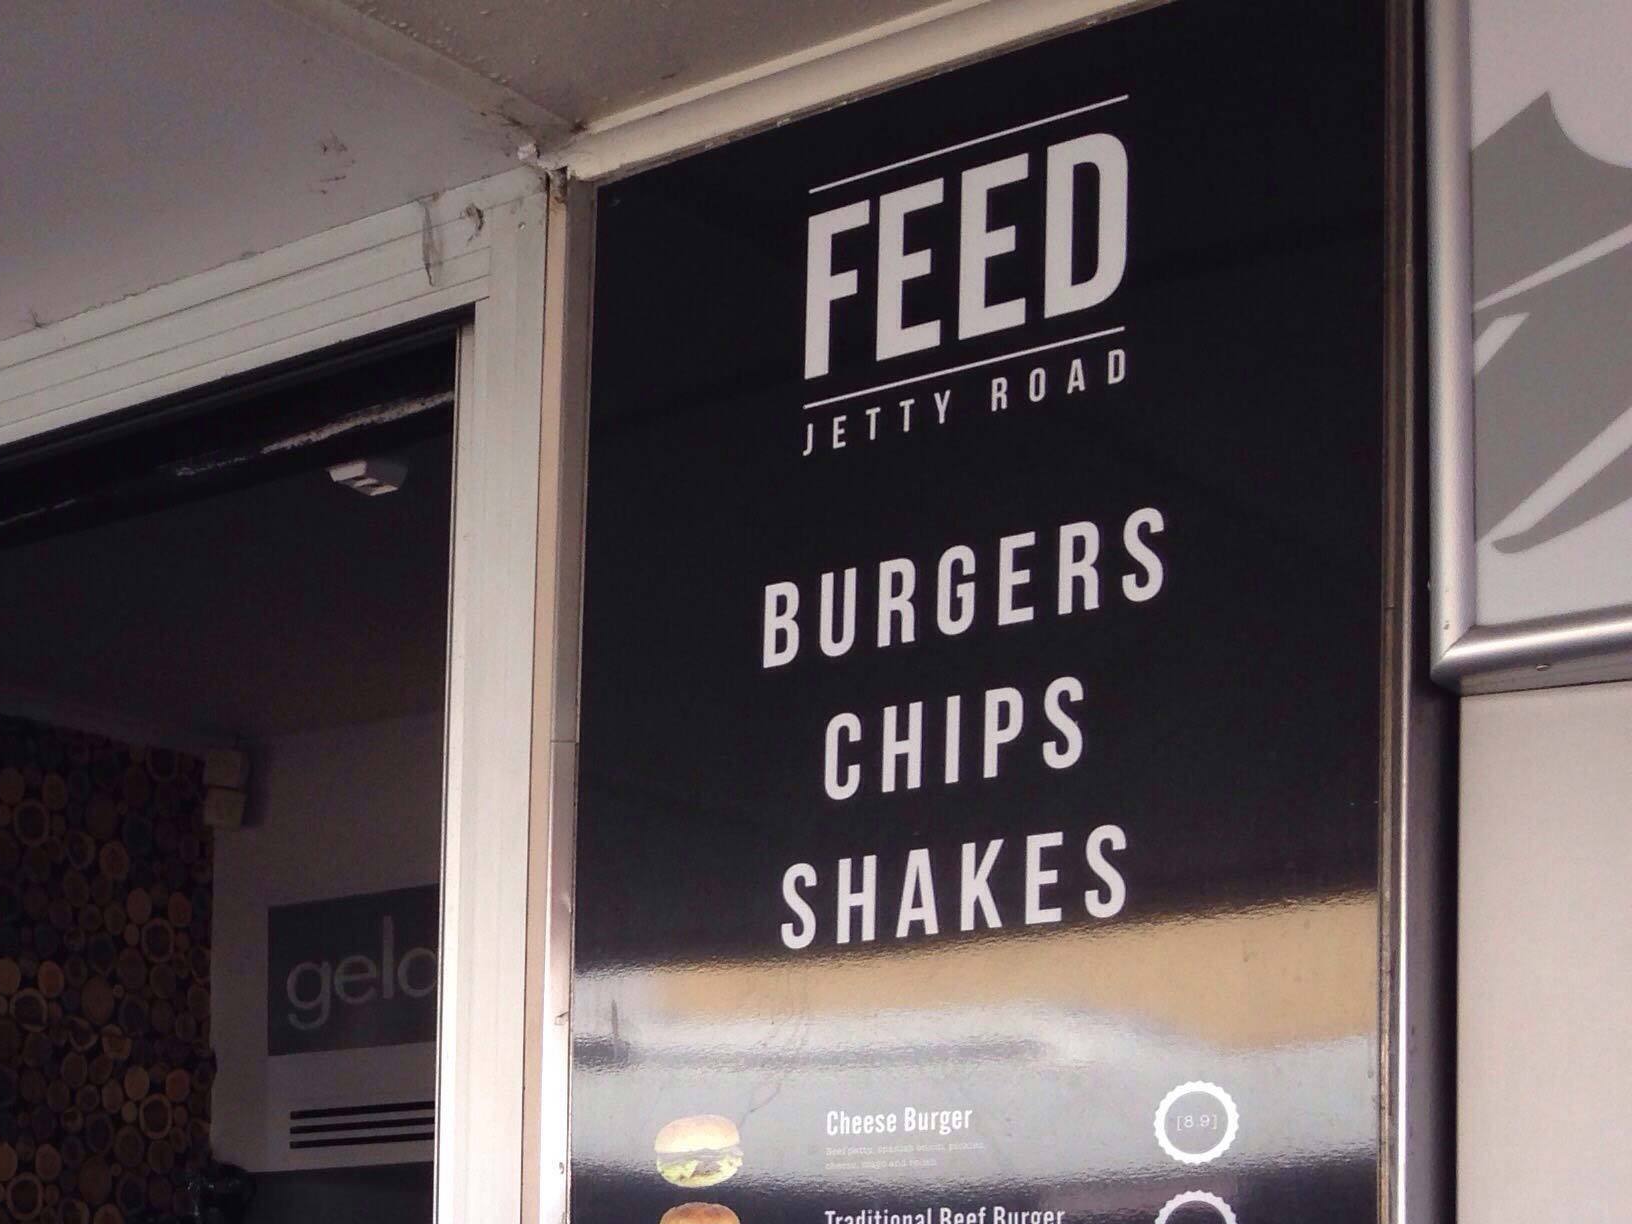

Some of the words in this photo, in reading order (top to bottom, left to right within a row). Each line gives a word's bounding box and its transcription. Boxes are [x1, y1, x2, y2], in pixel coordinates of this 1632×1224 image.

[804, 132, 1128, 381] FEED
[803, 390, 952, 457] JETTY
[991, 347, 1126, 412] ROAD
[763, 506, 1166, 669] BURGERS
[824, 676, 1085, 801] CHIPS
[780, 824, 1128, 949] SHAKES
[826, 1111, 897, 1135] Cheese
[904, 1107, 972, 1135] Burger
